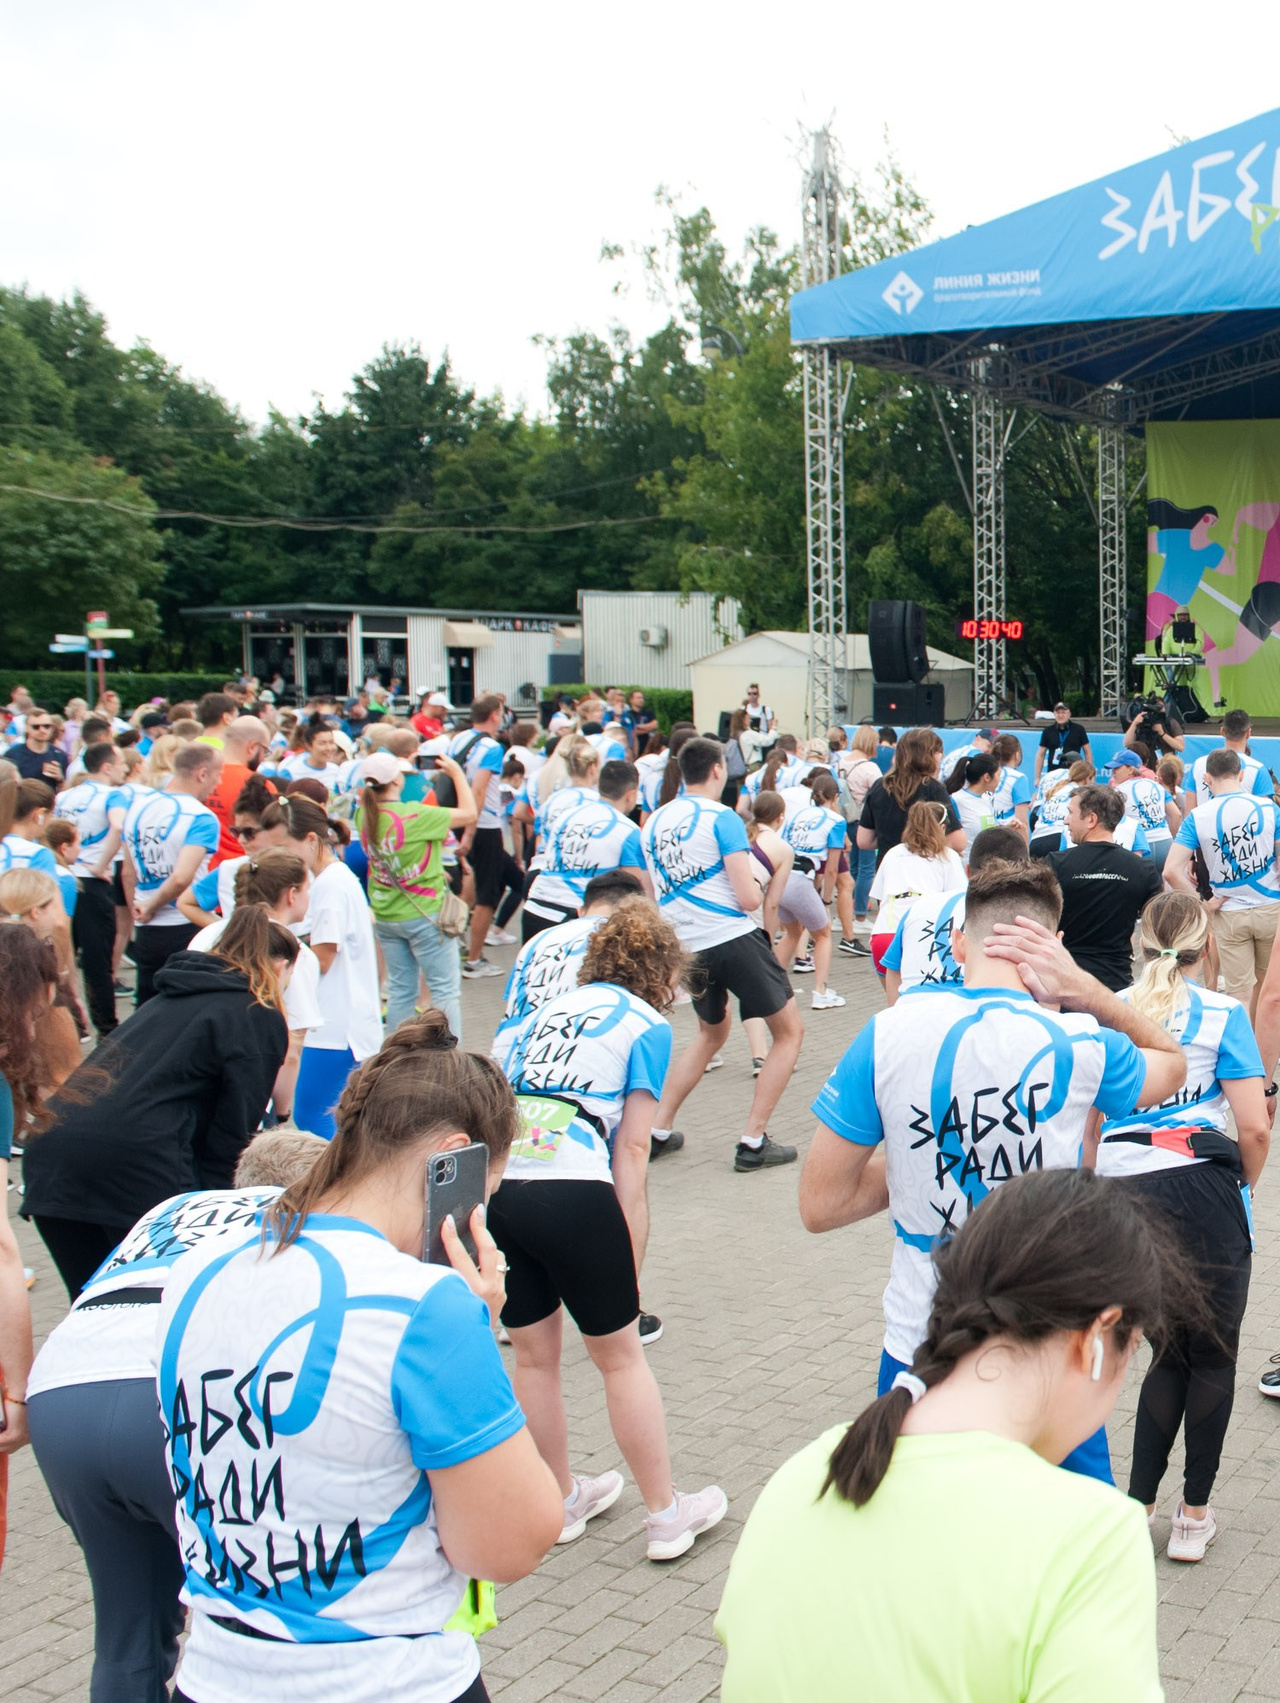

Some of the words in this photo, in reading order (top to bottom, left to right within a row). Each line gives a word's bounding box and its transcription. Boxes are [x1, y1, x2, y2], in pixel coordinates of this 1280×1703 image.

[934, 274, 983, 290] ЛИНИЯ
[987, 269, 1041, 286] ЖИЗНИ
[1212, 822, 1258, 852] ЗАБЕГ
[1221, 843, 1257, 865] РАДИ
[910, 1082, 1050, 1150] ЗАБЕГ
[935, 1137, 1044, 1191] РАДИ
[167, 1365, 294, 1458] АБЕГ
